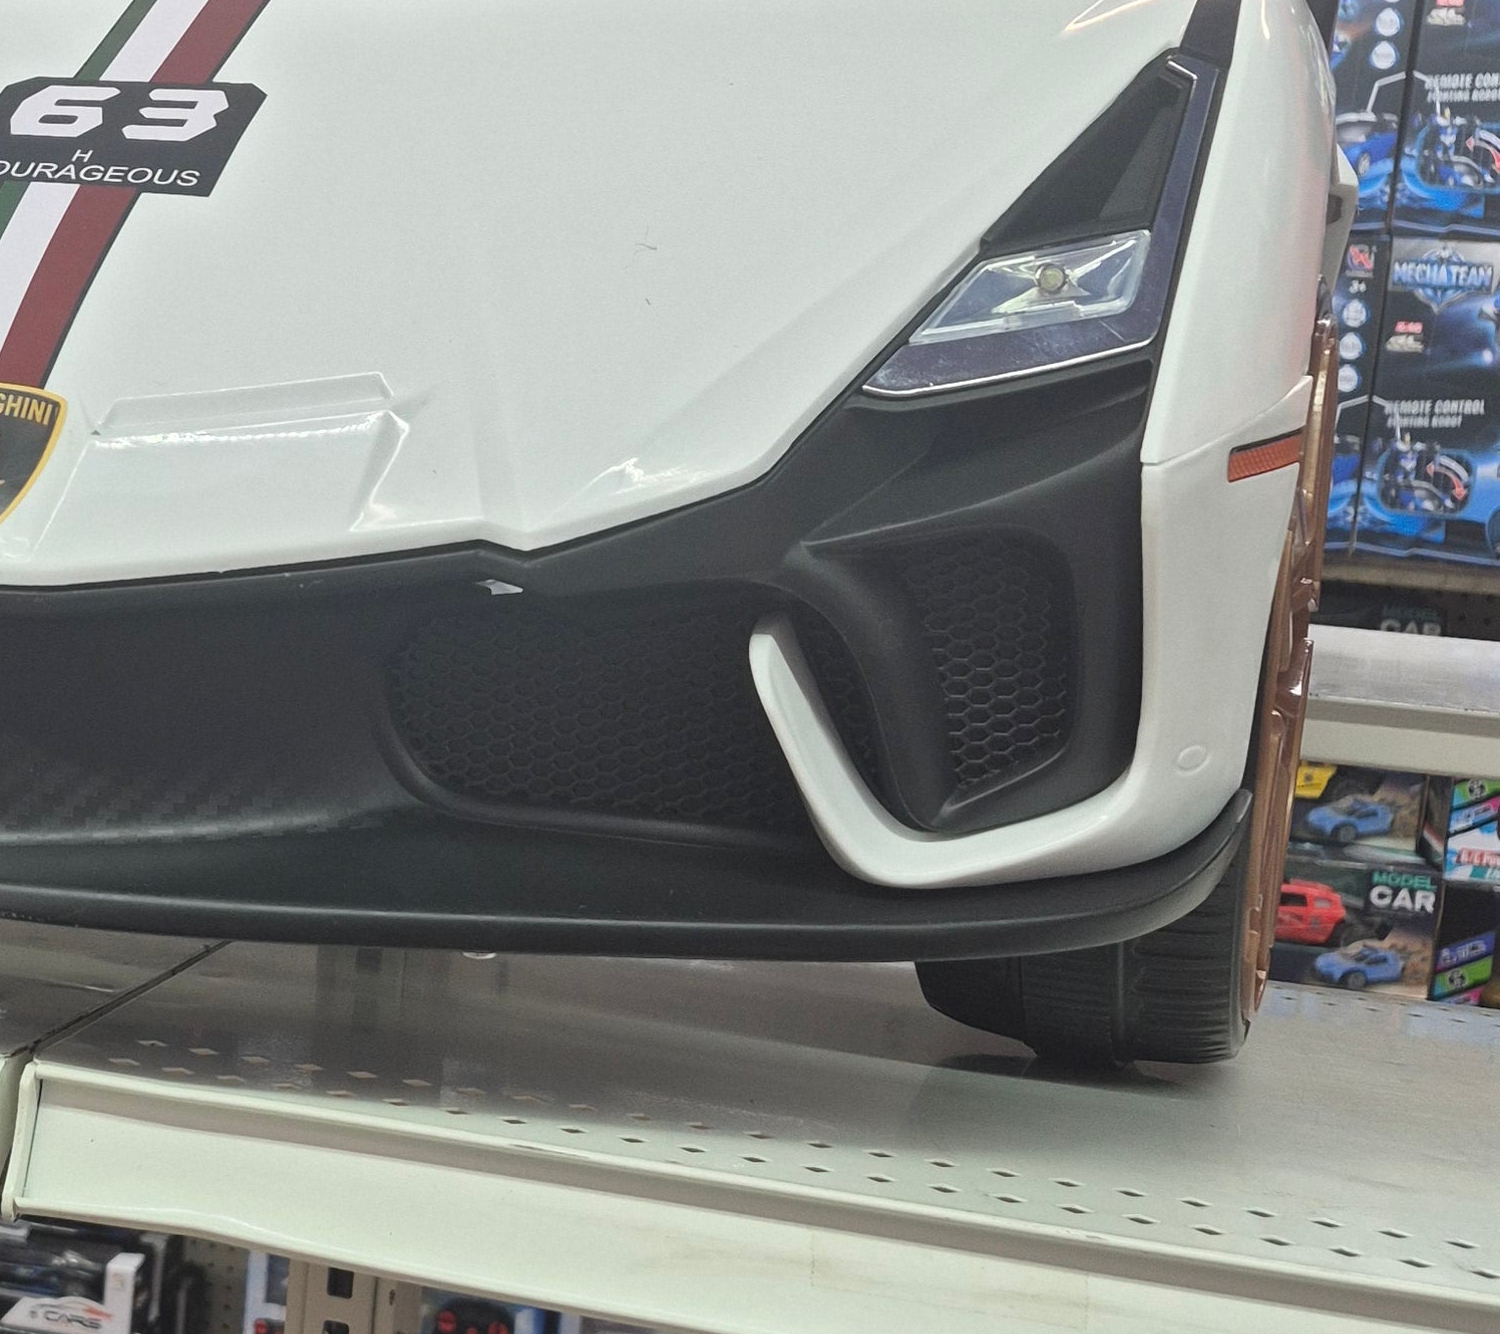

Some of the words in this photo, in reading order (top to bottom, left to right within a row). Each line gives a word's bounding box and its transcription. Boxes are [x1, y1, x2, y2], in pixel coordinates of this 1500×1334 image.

[10, 85, 230, 142] 63
[72, 150, 93, 163] H
[1433, 398, 1485, 415] CONTROL
[1372, 871, 1436, 893] MODEL
[1369, 885, 1436, 914] CAR
[43, 1309, 103, 1331] CARS
